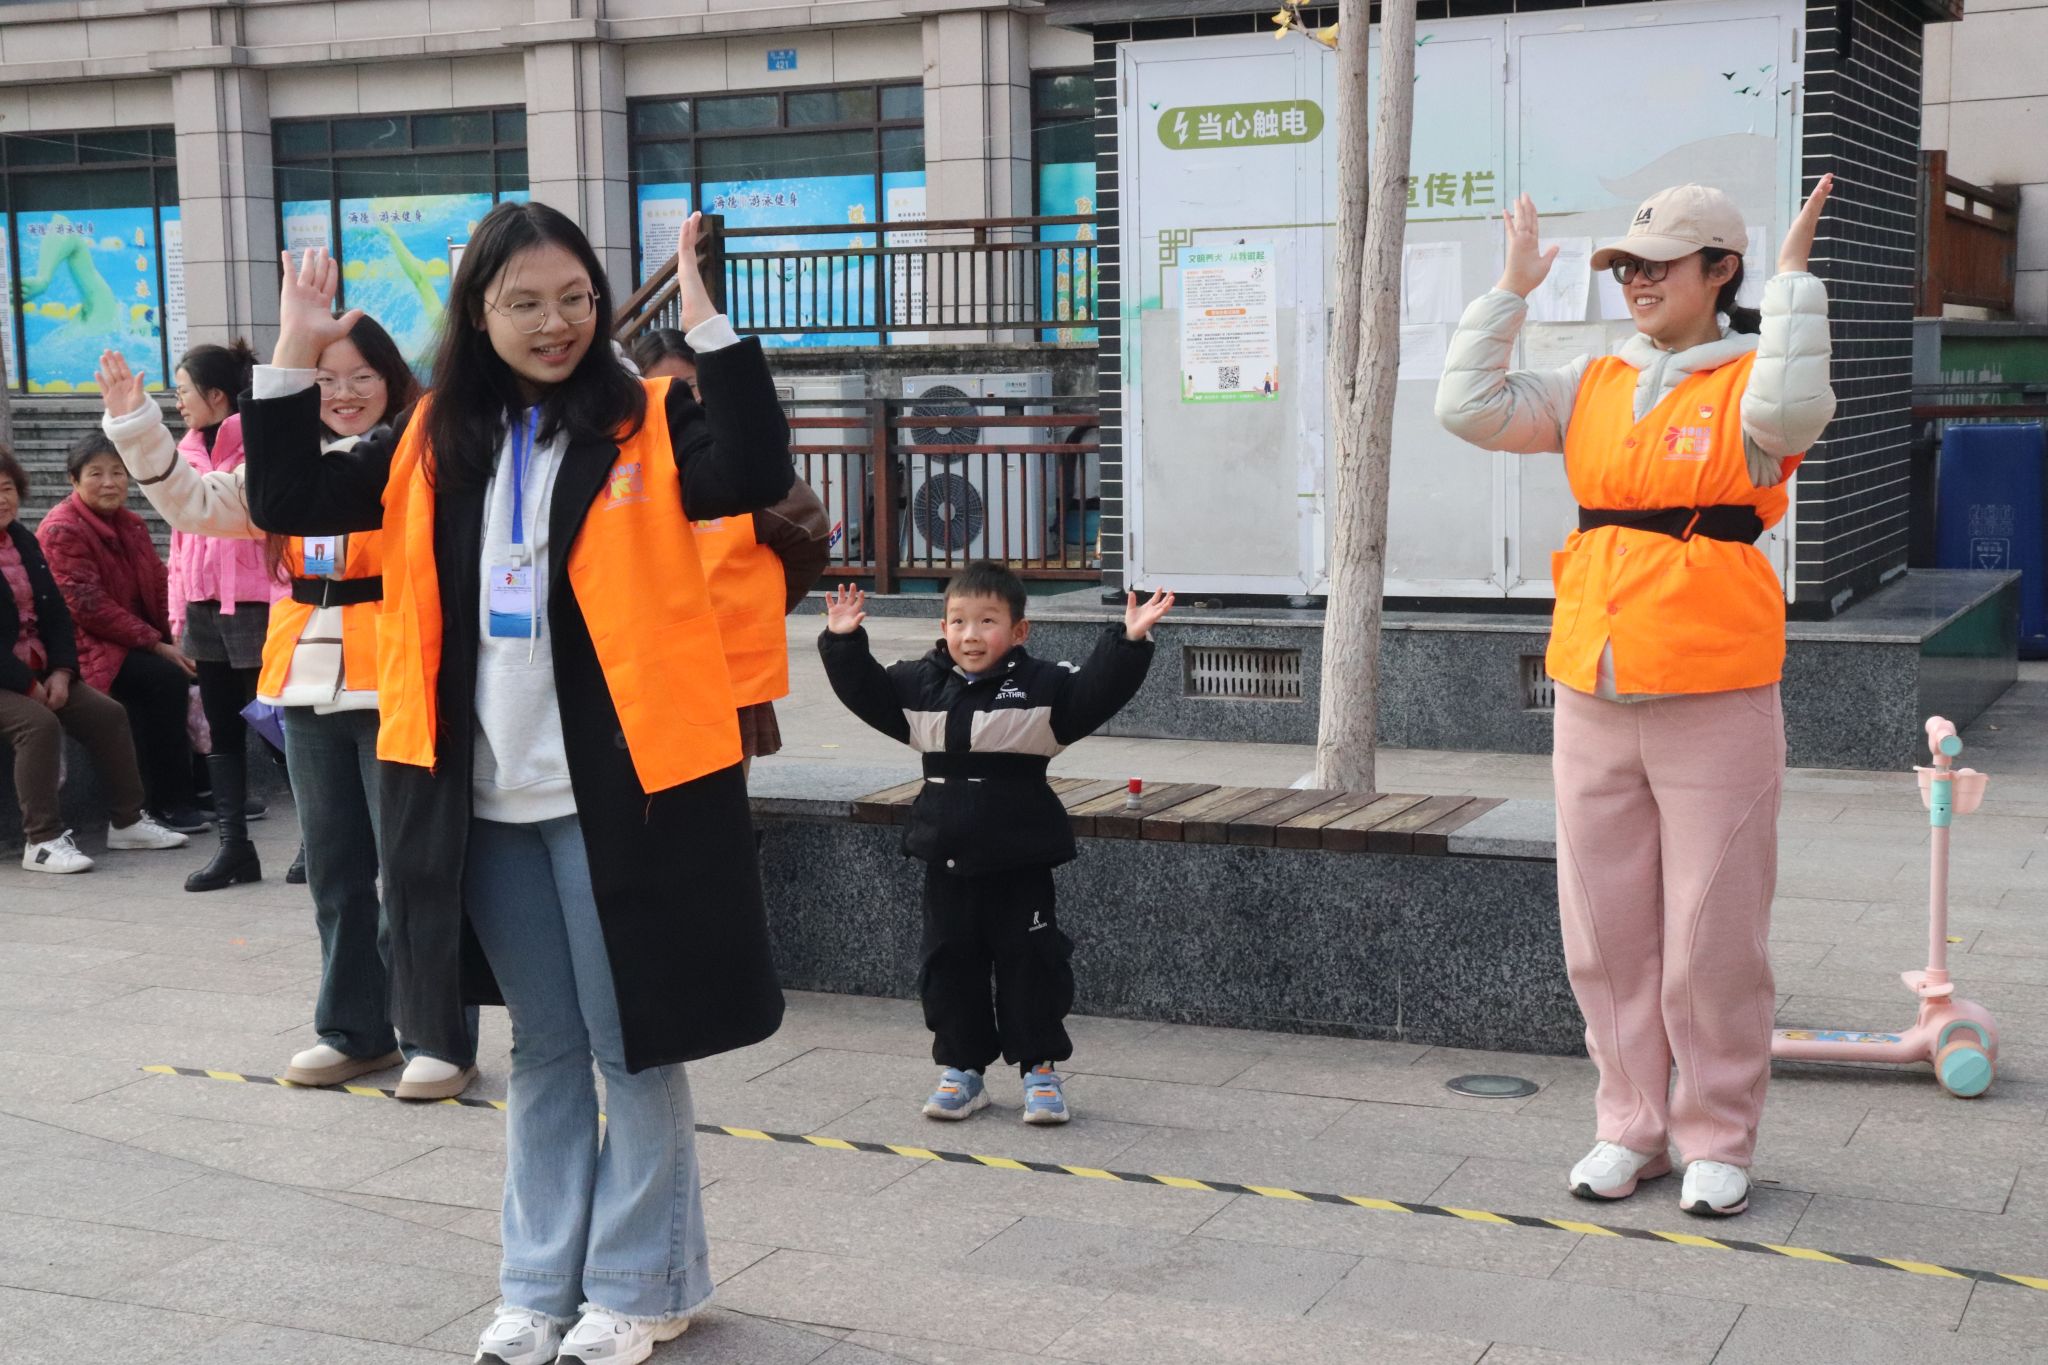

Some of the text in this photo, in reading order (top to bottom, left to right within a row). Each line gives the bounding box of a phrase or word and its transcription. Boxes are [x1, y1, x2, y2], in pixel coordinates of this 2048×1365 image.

[1198, 109, 1308, 142] 当心触电
[1188, 251, 1265, 263] 文明养犬 从我做起
